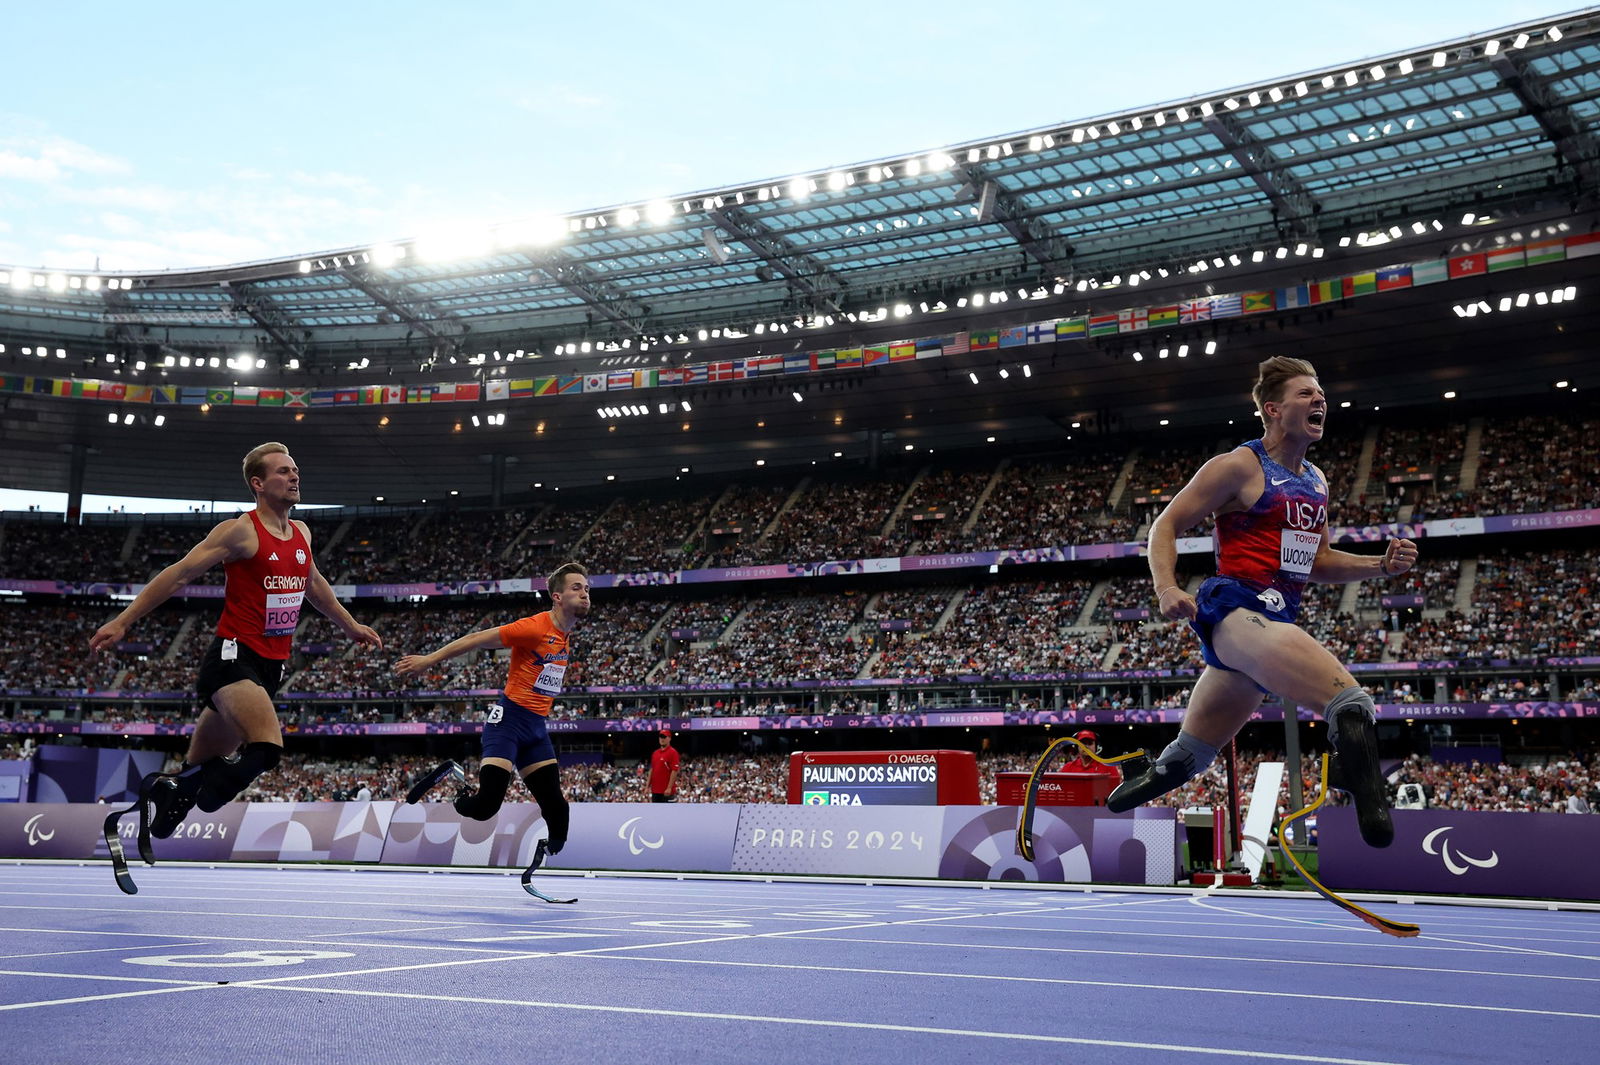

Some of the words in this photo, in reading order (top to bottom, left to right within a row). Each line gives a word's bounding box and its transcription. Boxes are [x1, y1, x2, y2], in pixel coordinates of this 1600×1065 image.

[1286, 501, 1326, 530] USA
[1511, 517, 1551, 527] PARIS
[1555, 513, 1593, 524] 2024
[1294, 534, 1318, 544] TOYOTA
[919, 558, 946, 567] PARIS
[950, 556, 976, 564] 2024
[1283, 547, 1315, 567] WOODH
[725, 569, 750, 578] PARIS
[752, 567, 777, 576] 2024
[263, 575, 307, 590] GERMANY
[278, 596, 301, 604] TOYOTA
[1399, 706, 1431, 715] PARIS
[1435, 705, 1465, 714] 2024
[702, 720, 725, 728] PARIS
[939, 715, 964, 724] PARIS
[967, 714, 990, 723] 2024
[899, 754, 937, 764] OMEGA
[803, 767, 856, 782] PAULINO
[859, 767, 884, 782] DOS
[887, 766, 936, 782] SANTOS
[1038, 783, 1062, 791] MEGA
[831, 793, 863, 805] BRA
[173, 822, 228, 839] 2024
[846, 830, 923, 851] 2024
